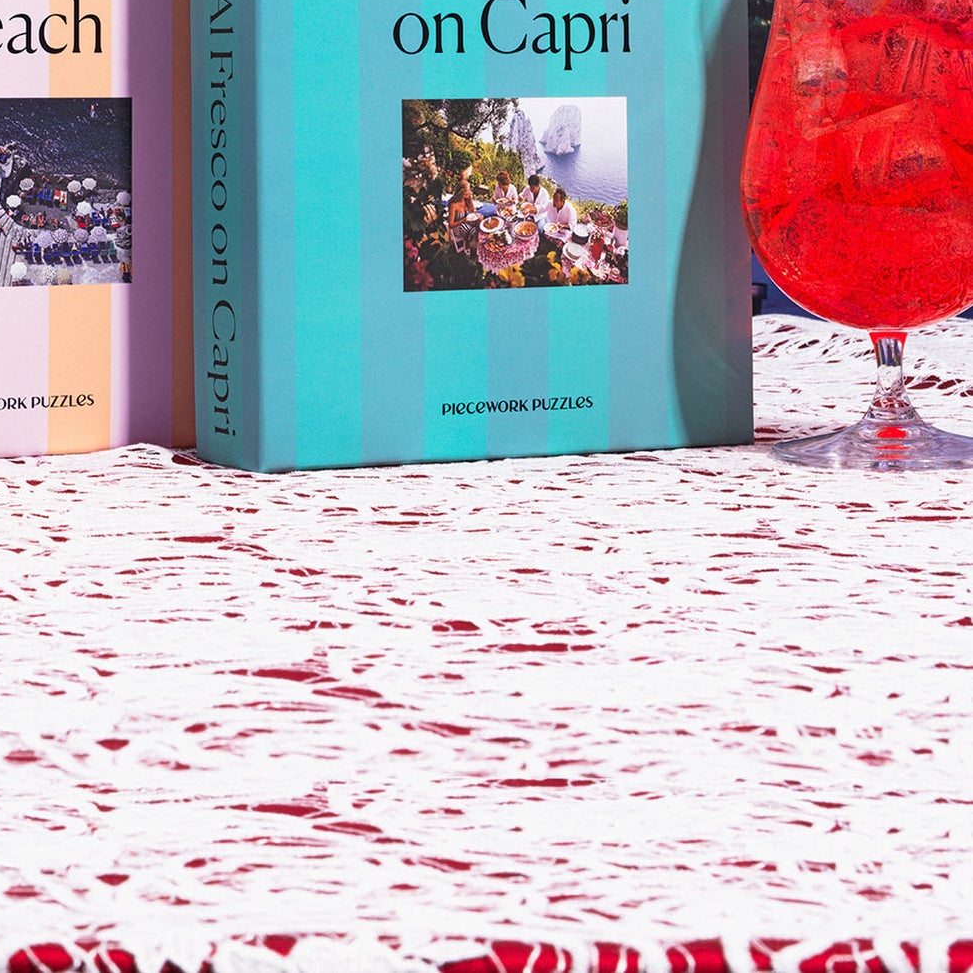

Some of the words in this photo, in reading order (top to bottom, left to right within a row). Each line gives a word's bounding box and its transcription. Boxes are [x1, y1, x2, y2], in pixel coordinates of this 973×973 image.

[392, 12, 466, 55] on
[209, 49, 234, 212] Fresco
[210, 222, 229, 286] on
[206, 299, 237, 437] Capri
